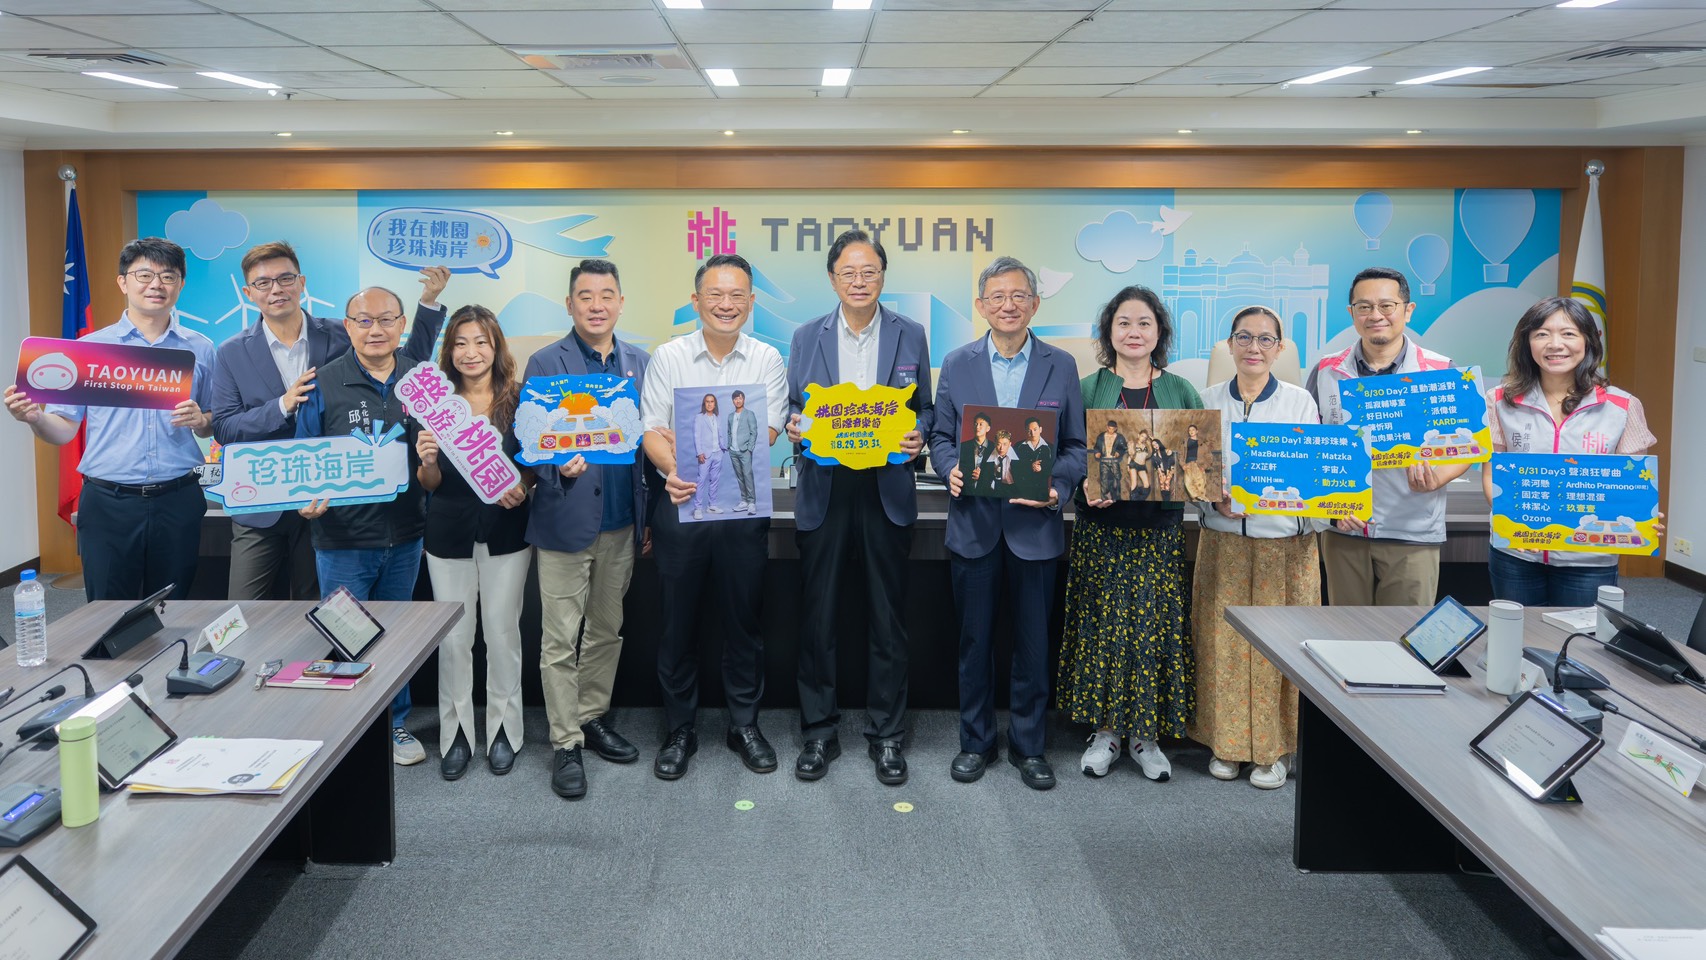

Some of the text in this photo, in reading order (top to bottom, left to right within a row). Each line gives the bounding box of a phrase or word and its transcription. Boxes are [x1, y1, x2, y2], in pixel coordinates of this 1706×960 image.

[388, 218, 469, 239] 我在桃園
[688, 206, 736, 260] 桃
[761, 217, 993, 251] TAOYUAN
[387, 238, 468, 258] 珍珠海岸
[87, 364, 182, 384] TAOYUAN
[83, 380, 181, 393] First Stop in Taiwan
[1364, 389, 1384, 397] 8/30
[1386, 386, 1408, 396] Day2
[814, 400, 899, 418] 桃園珍珠海岸
[1366, 410, 1403, 420] 好日HoNi
[832, 417, 881, 429] 國際音樂節
[1432, 418, 1457, 426] KARD
[1260, 436, 1348, 446] 8/29 Day1 浪漫珍珠樂
[1250, 450, 1309, 459] MazBar&Lalan
[1322, 453, 1352, 461] Matzka
[247, 450, 375, 486] 珍珠海岸
[1322, 465, 1348, 474] 宇宙人
[1518, 467, 1621, 477] 8/31 Day3 聲浪狂響曲
[1322, 478, 1356, 488] 動力火車
[1566, 481, 1596, 489] Ardhito
[1521, 490, 1550, 500] 固定客
[1566, 492, 1606, 502] 理想混蛋
[1521, 501, 1551, 511] 林潔心
[1521, 514, 1552, 523] Ozone
